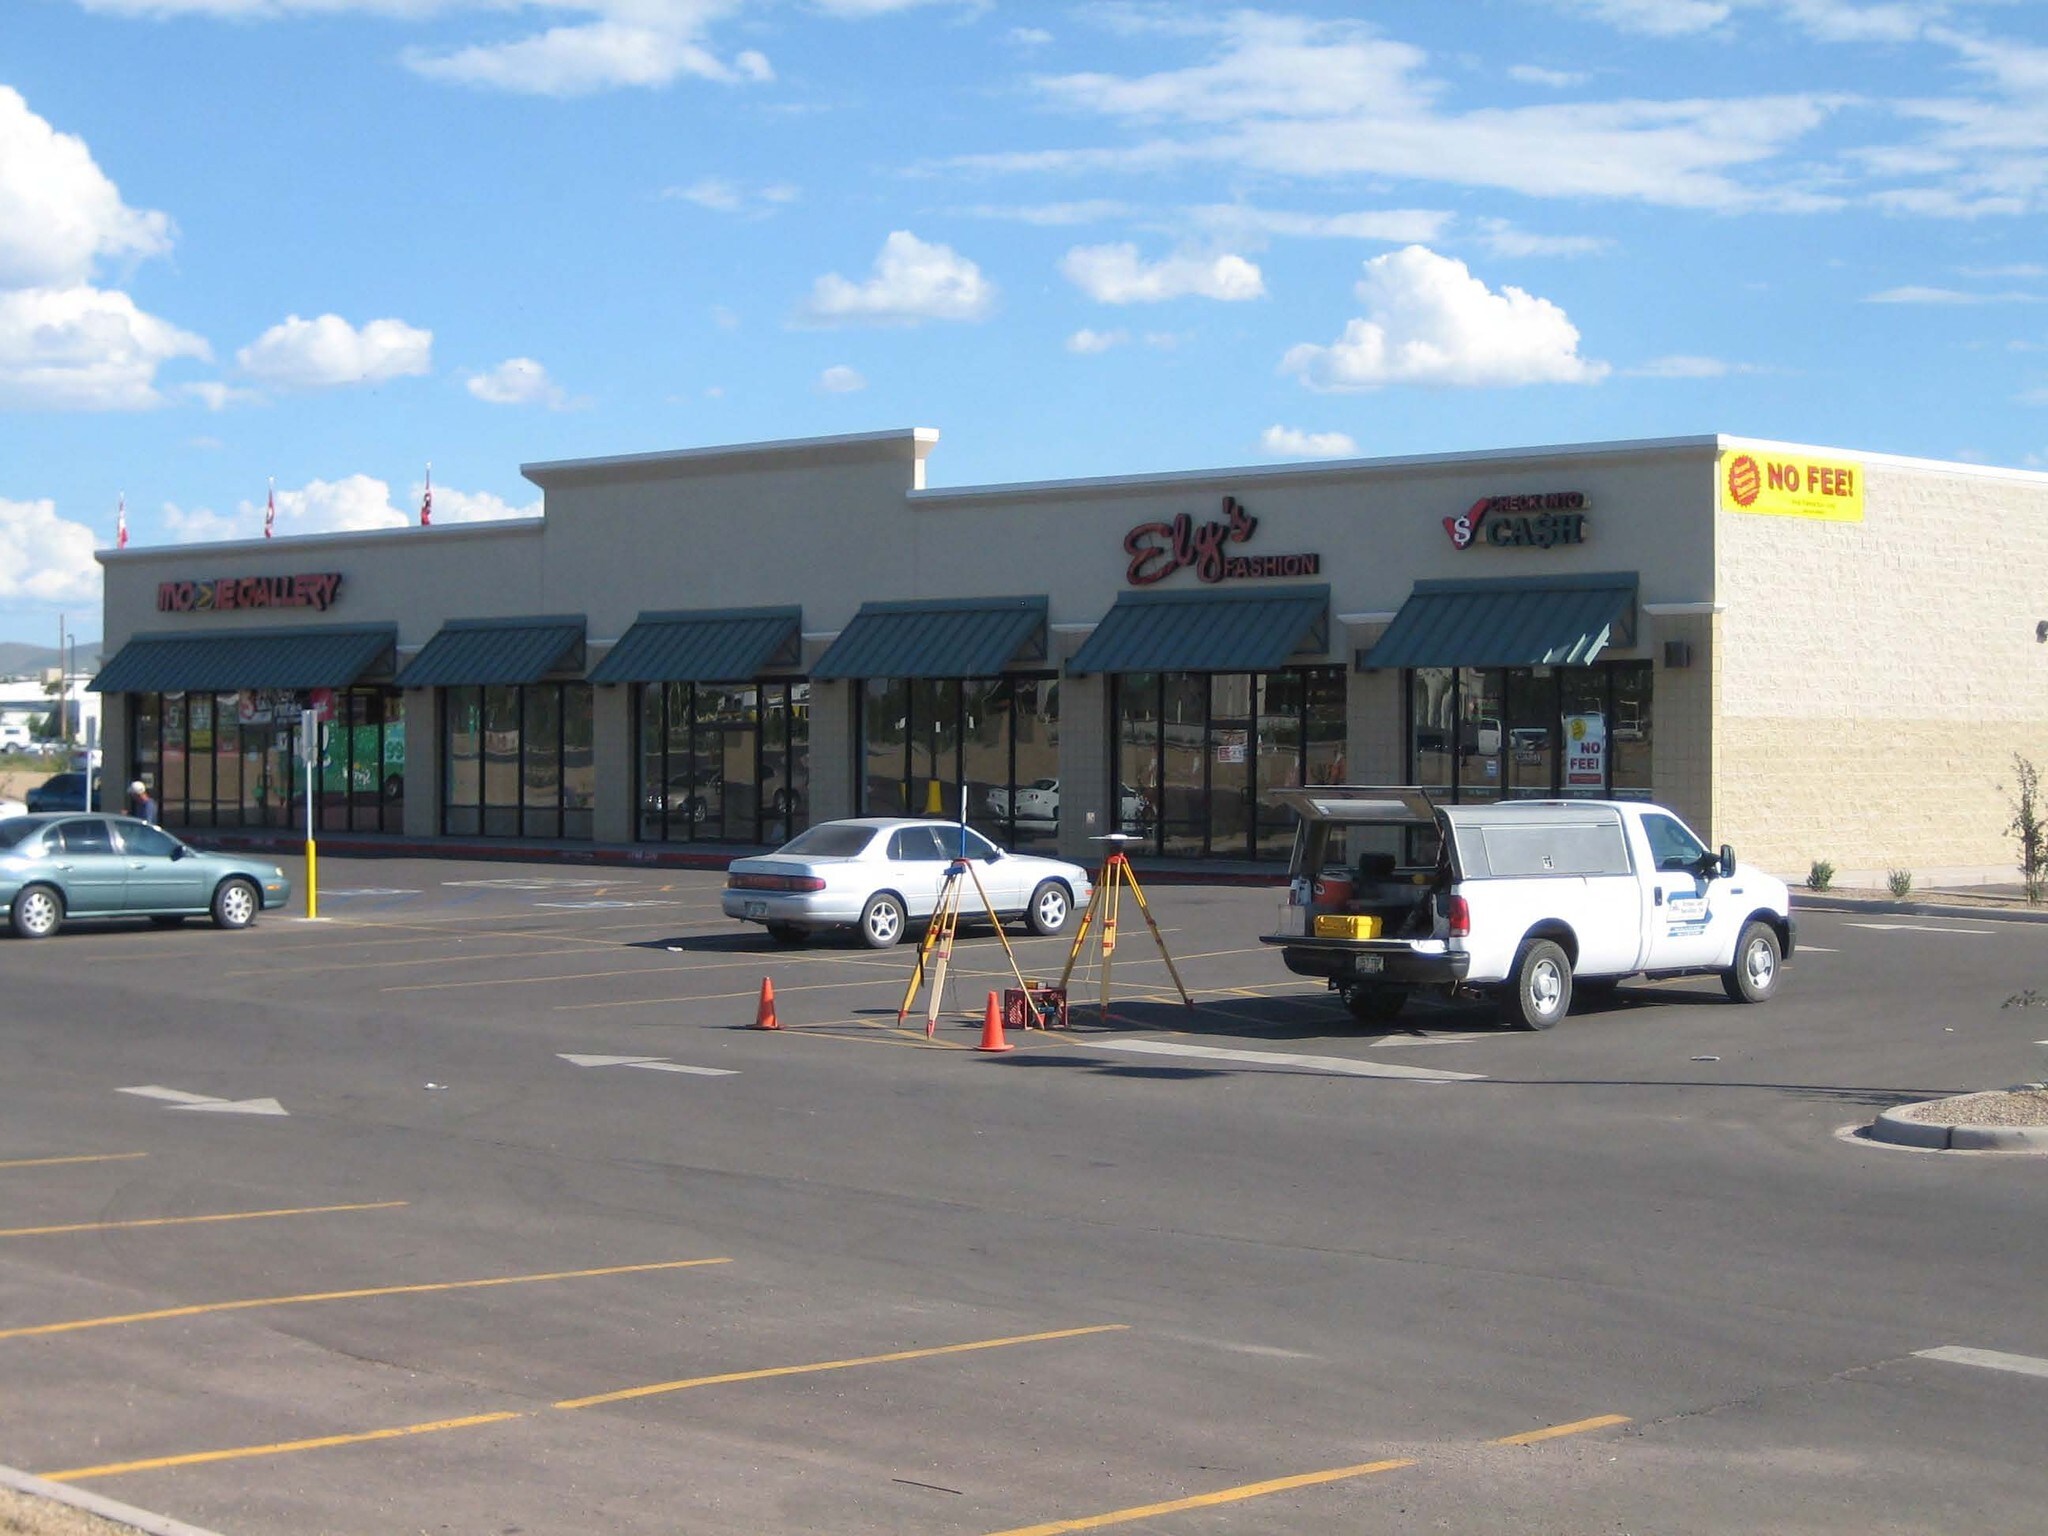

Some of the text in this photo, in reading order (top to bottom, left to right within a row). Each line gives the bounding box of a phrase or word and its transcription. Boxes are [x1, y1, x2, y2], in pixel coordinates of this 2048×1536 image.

[1767, 462, 1799, 493] NO
[1807, 465, 1853, 497] FEE!
[1124, 496, 1257, 585] Ely's
[1224, 553, 1318, 577] FASHION
[238, 573, 341, 611] GALLERY
[1580, 742, 1600, 754] NO
